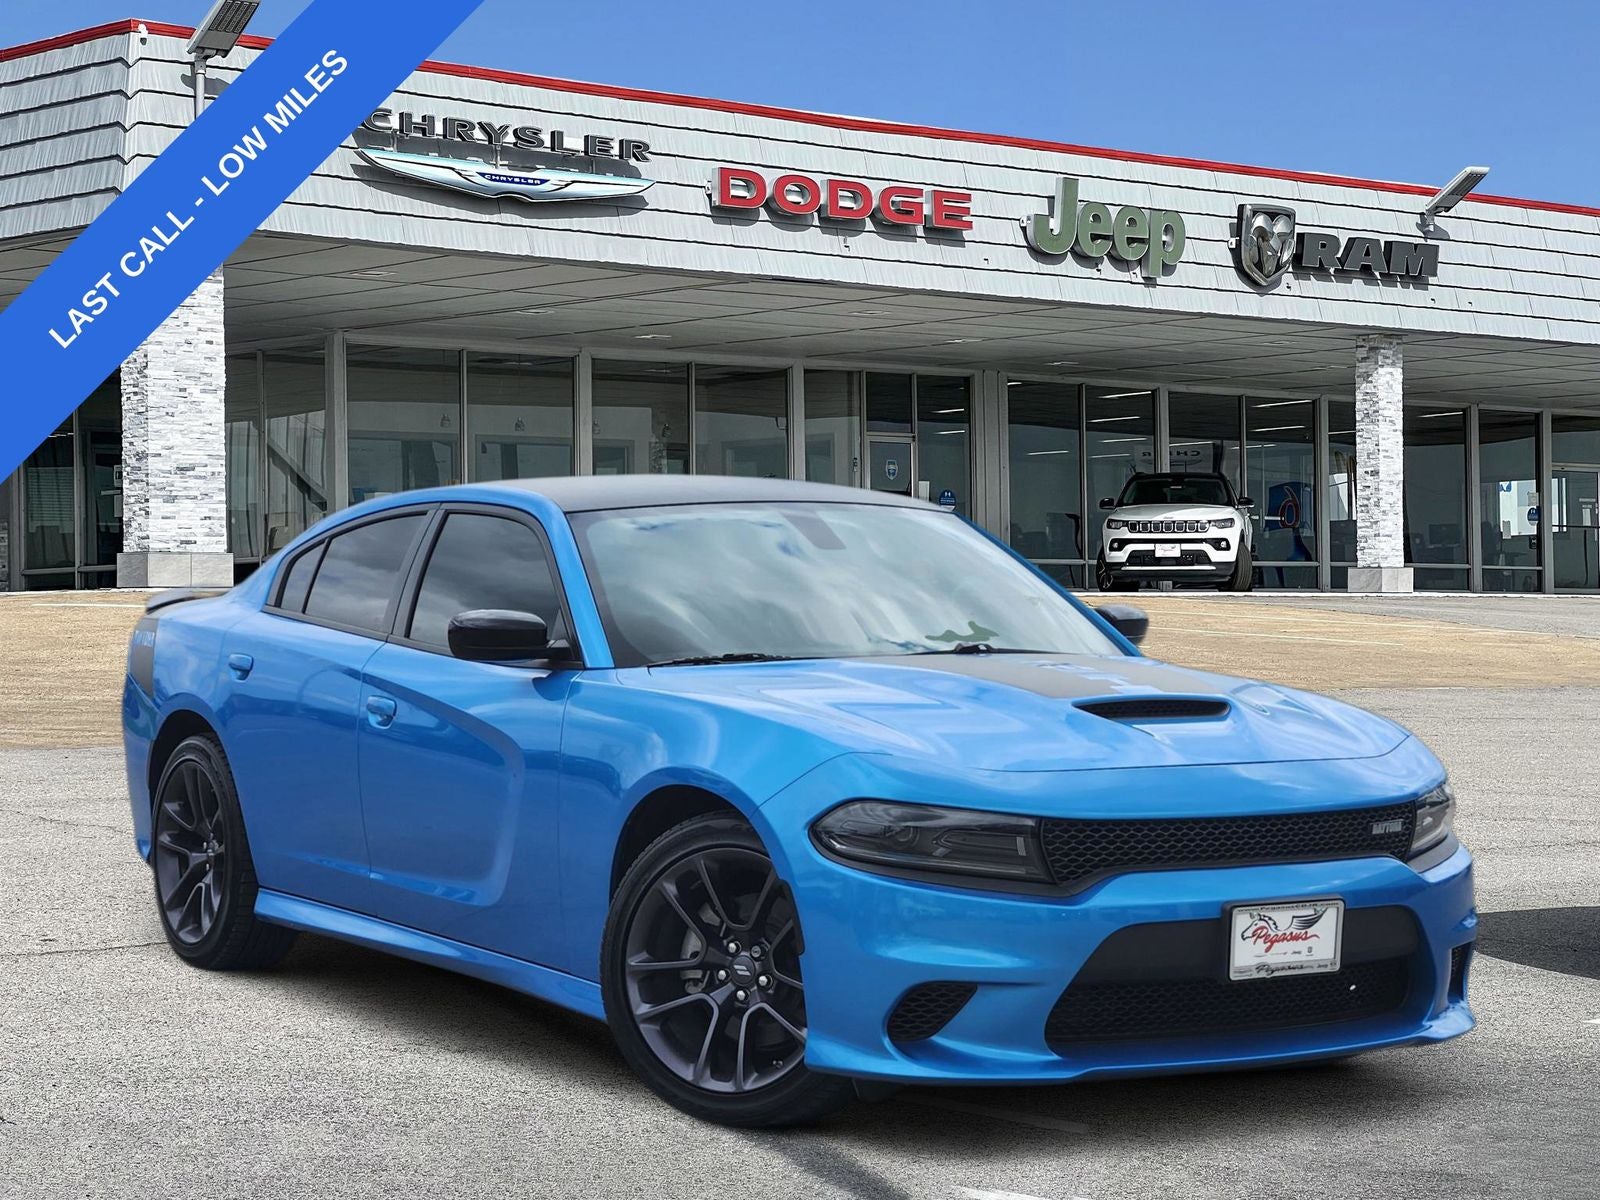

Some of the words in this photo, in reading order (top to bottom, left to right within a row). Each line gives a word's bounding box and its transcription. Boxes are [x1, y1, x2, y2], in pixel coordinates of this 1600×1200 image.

[361, 107, 652, 163] CHRYSLER
[484, 174, 541, 185] CHRYSLER
[711, 166, 973, 231] DODGE
[1026, 176, 1187, 279] Jeep
[1294, 232, 1440, 278] RAM
[1251, 925, 1320, 953] Pegasus
